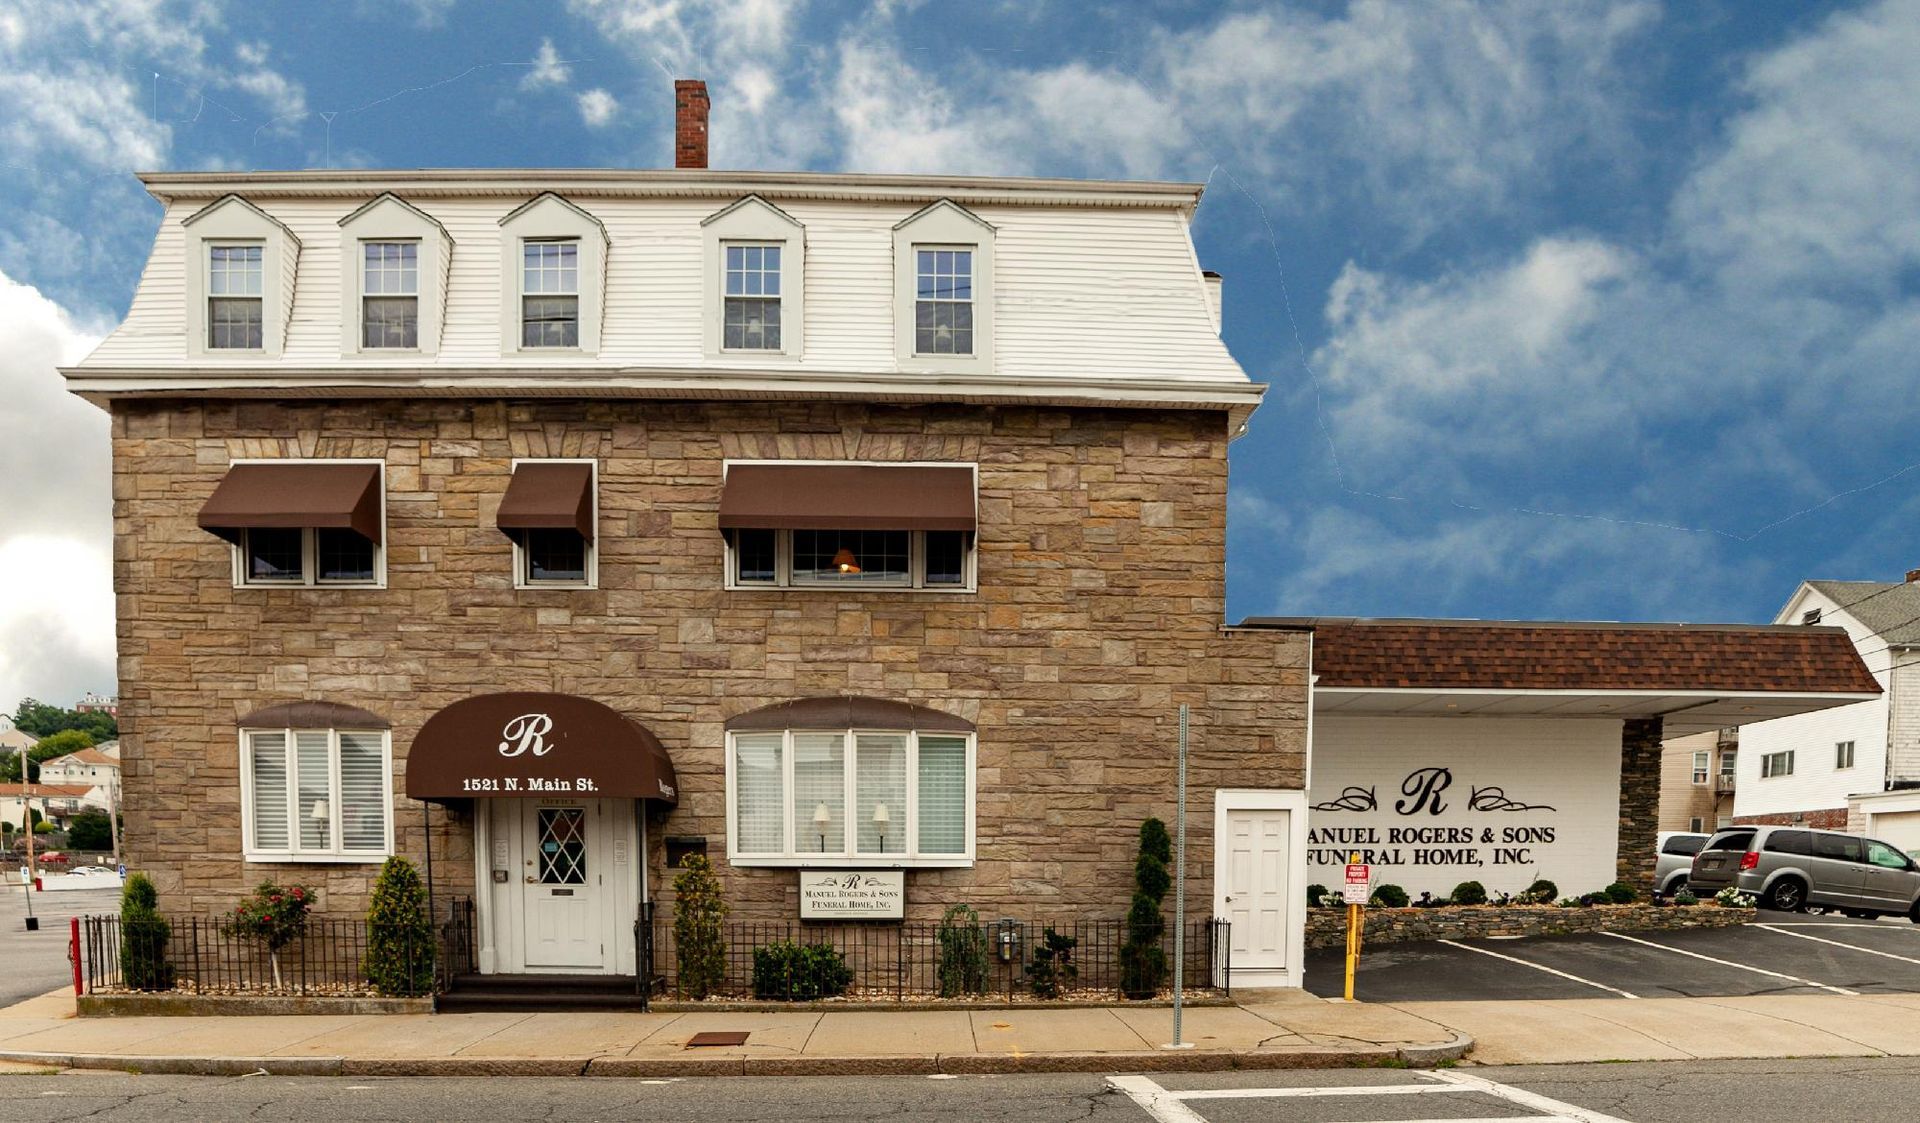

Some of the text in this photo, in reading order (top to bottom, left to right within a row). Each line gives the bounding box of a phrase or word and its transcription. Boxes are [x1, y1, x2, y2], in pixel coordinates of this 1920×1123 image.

[498, 713, 554, 758] R
[463, 778, 599, 791] 1521 N. Main St.
[1395, 767, 1453, 816] R
[1307, 827, 1555, 844] ANUEL ROGERS & SONS
[1307, 848, 1534, 867] FUNERAL HOME, INC.
[842, 874, 861, 890] R
